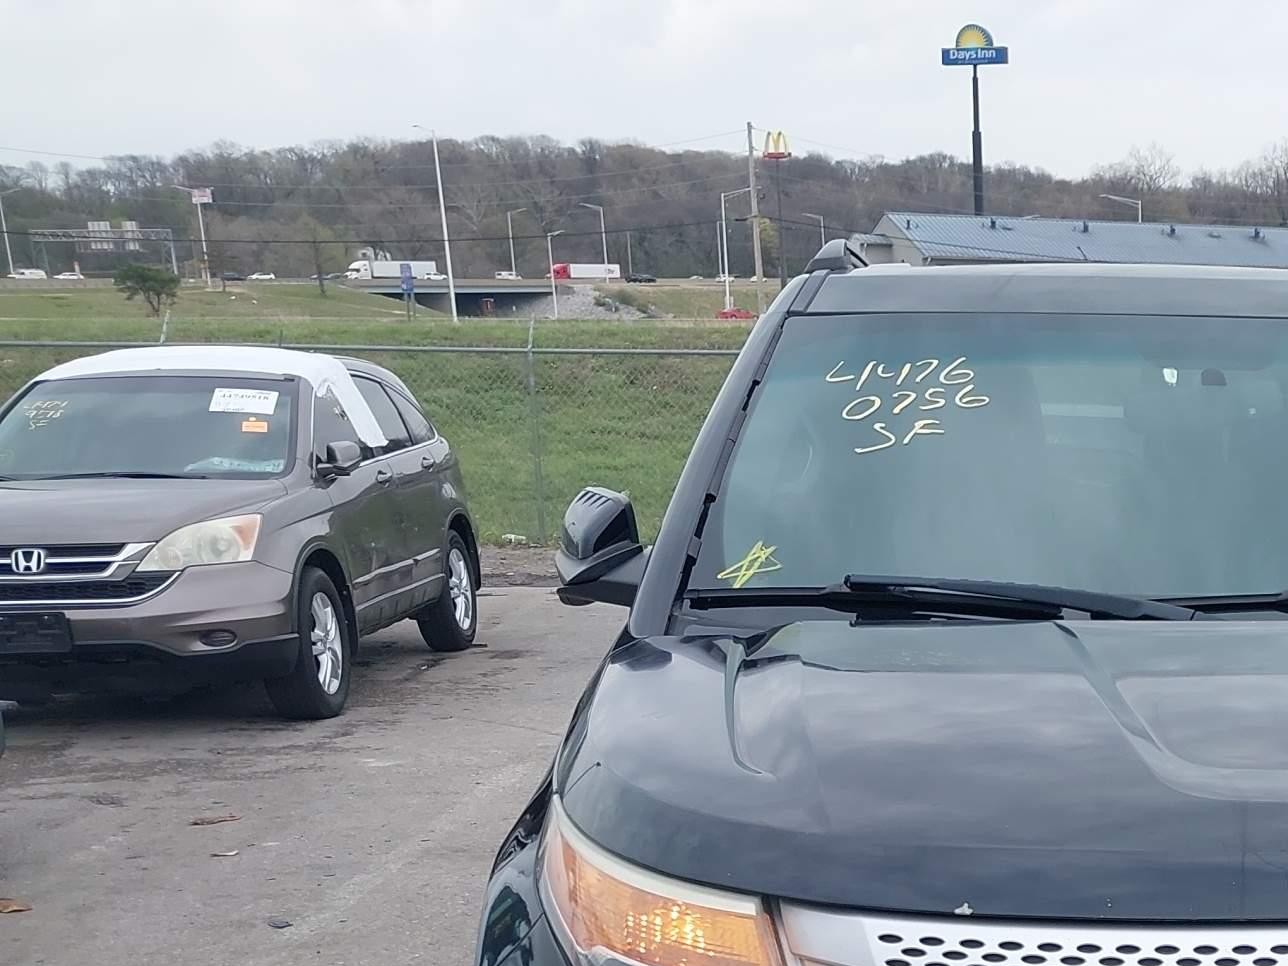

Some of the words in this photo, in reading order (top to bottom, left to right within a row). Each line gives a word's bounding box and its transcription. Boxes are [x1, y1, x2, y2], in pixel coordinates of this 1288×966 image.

[949, 49, 977, 60] Days
[977, 48, 996, 59] Inn
[841, 384, 990, 420] 0756
[854, 419, 945, 454] SF
